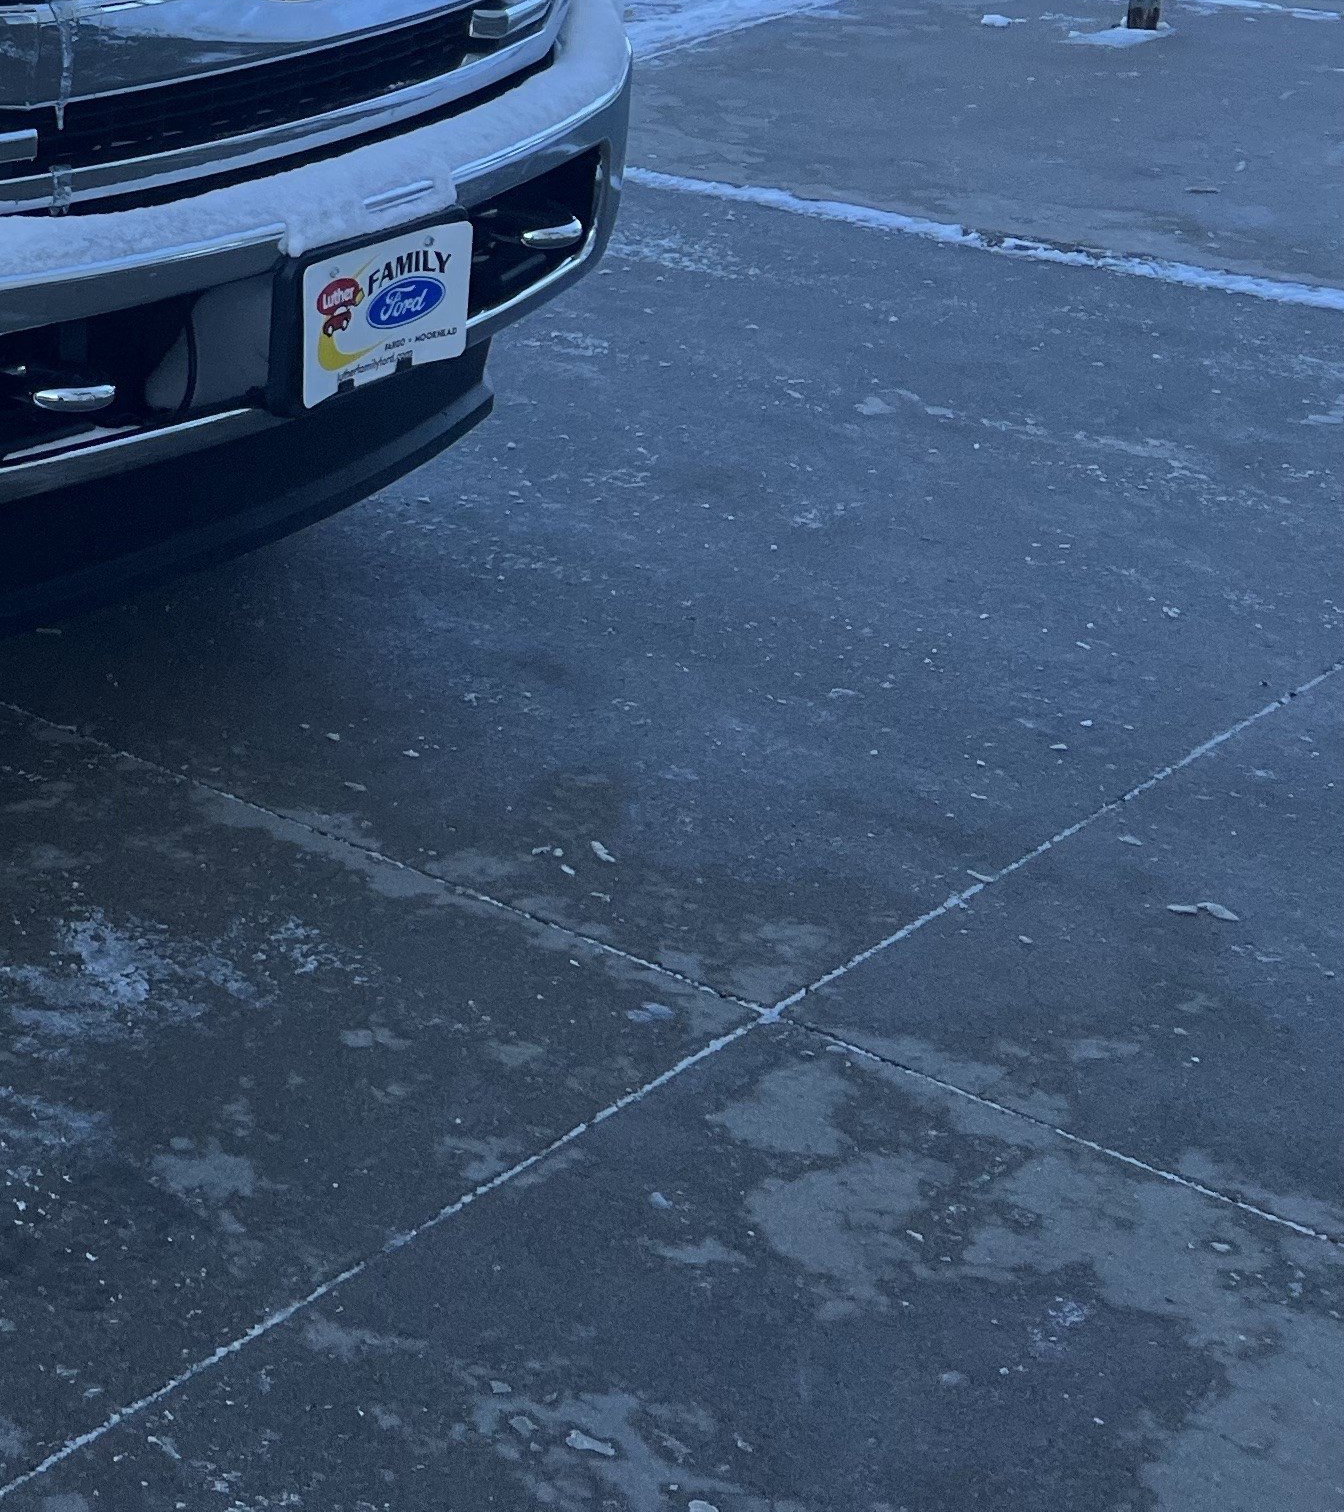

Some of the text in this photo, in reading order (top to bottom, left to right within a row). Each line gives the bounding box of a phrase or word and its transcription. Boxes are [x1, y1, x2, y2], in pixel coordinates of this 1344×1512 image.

[367, 249, 452, 297] FAMILY
[322, 286, 356, 310] Luther
[379, 284, 429, 322] Ford
